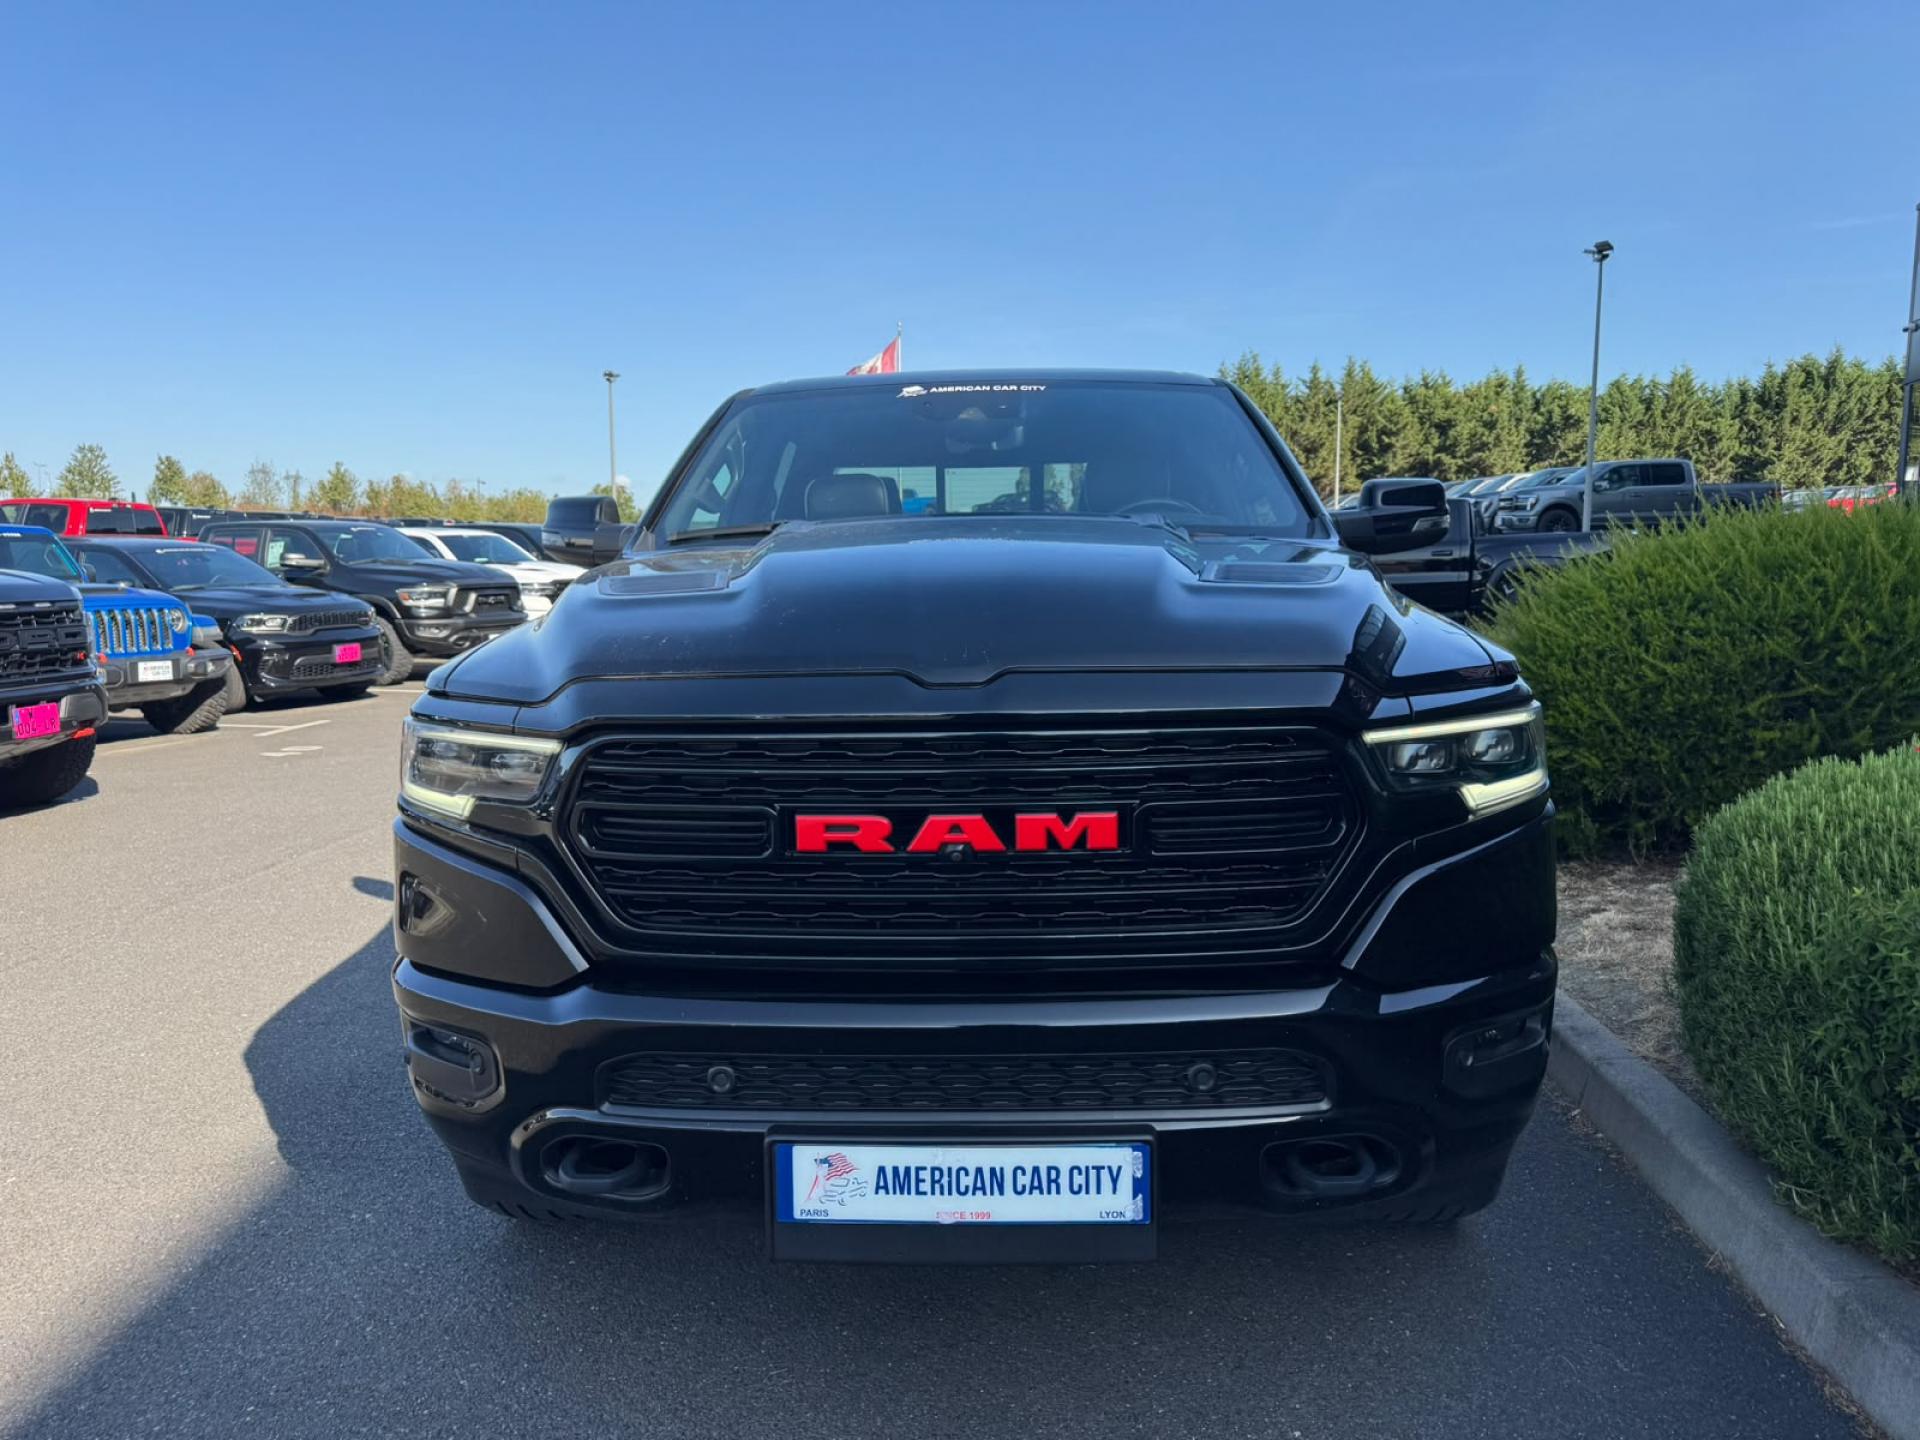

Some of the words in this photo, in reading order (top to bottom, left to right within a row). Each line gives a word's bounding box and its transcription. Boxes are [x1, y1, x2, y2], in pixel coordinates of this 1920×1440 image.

[929, 384, 991, 393] AMERICAN
[795, 810, 1119, 852] RAM
[874, 1165, 1005, 1196] AMERICAN
[1012, 1165, 1061, 1195] CAR
[1068, 1165, 1123, 1195] CITY
[800, 1208, 829, 1218] PARIS
[935, 1210, 967, 1220] SCE
[970, 1210, 991, 1220] 1999
[1100, 1210, 1126, 1219] LYON
